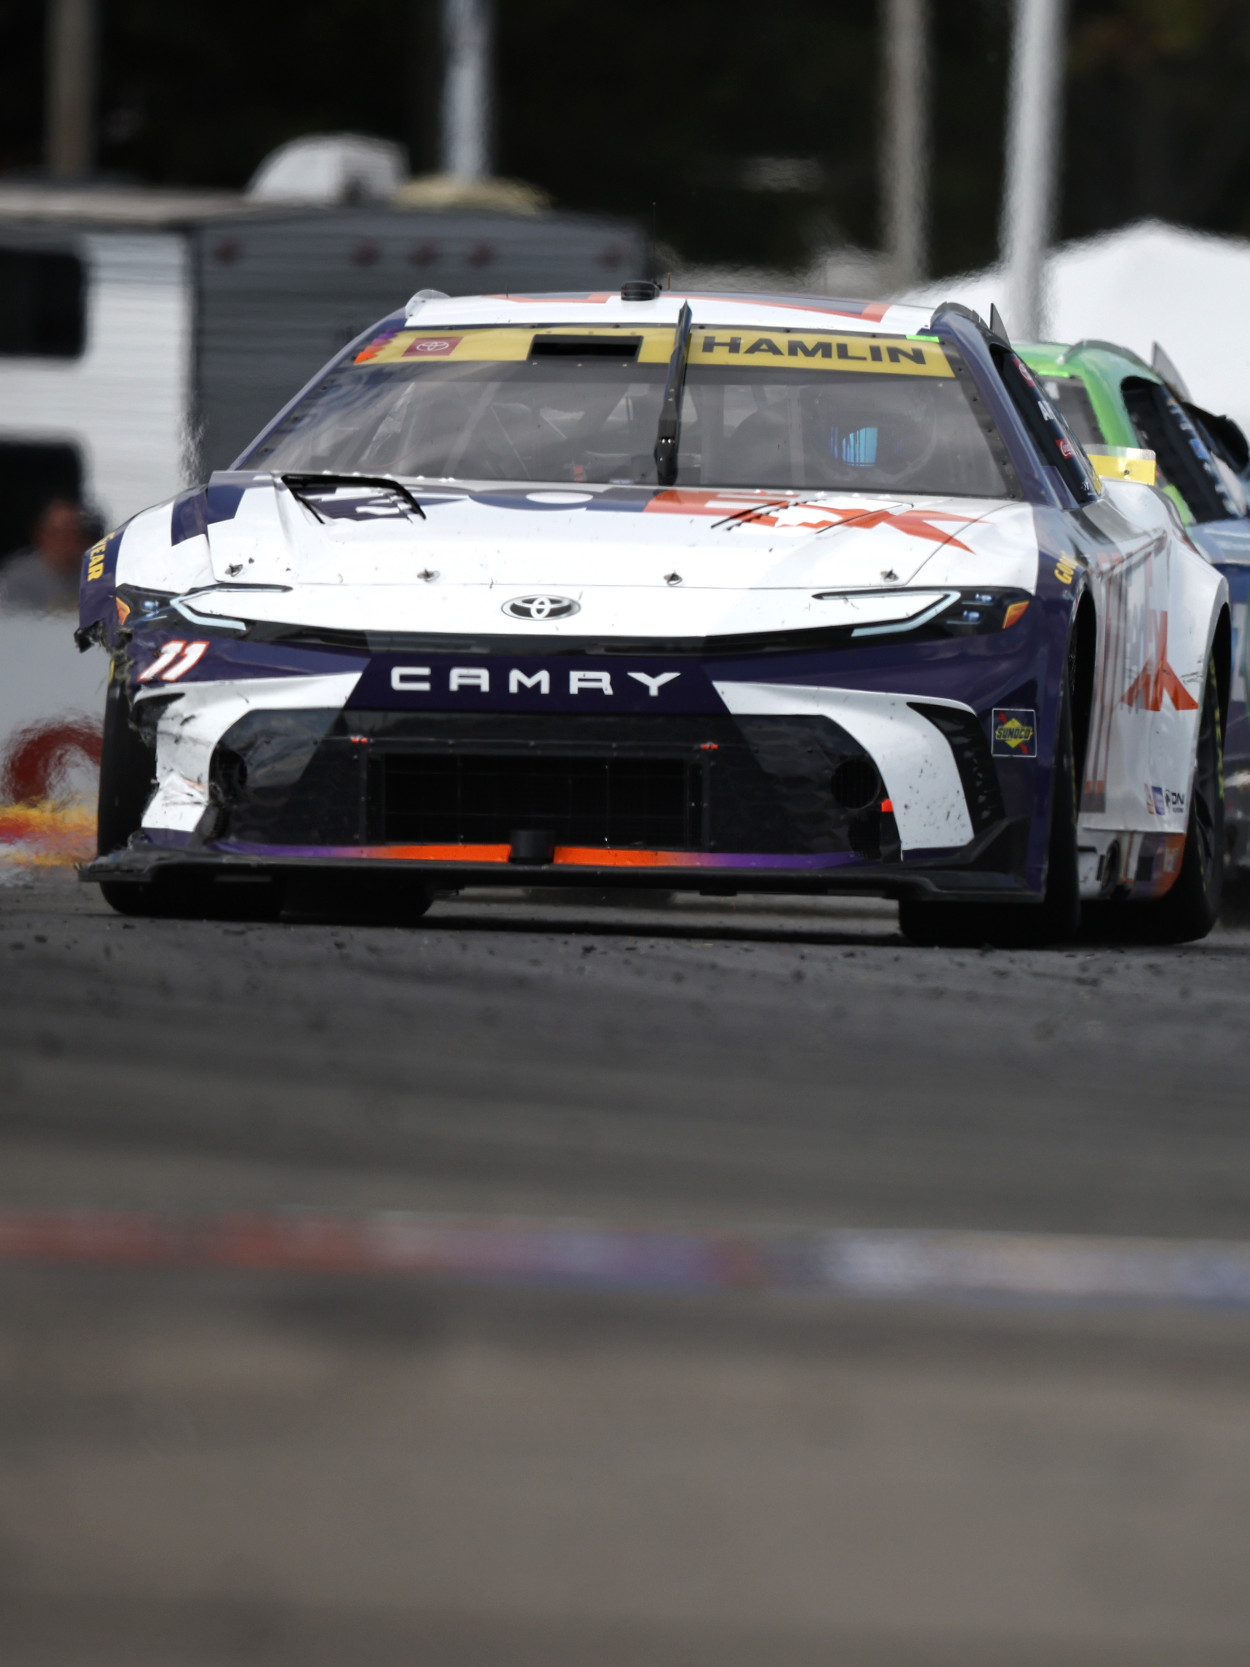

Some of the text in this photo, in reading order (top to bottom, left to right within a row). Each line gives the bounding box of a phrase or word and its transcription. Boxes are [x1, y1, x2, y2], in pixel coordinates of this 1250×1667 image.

[702, 335, 927, 365] HAMLIN
[138, 640, 210, 681] 11
[391, 666, 682, 697] CAMRY
[996, 727, 1032, 740] SUNOCO
